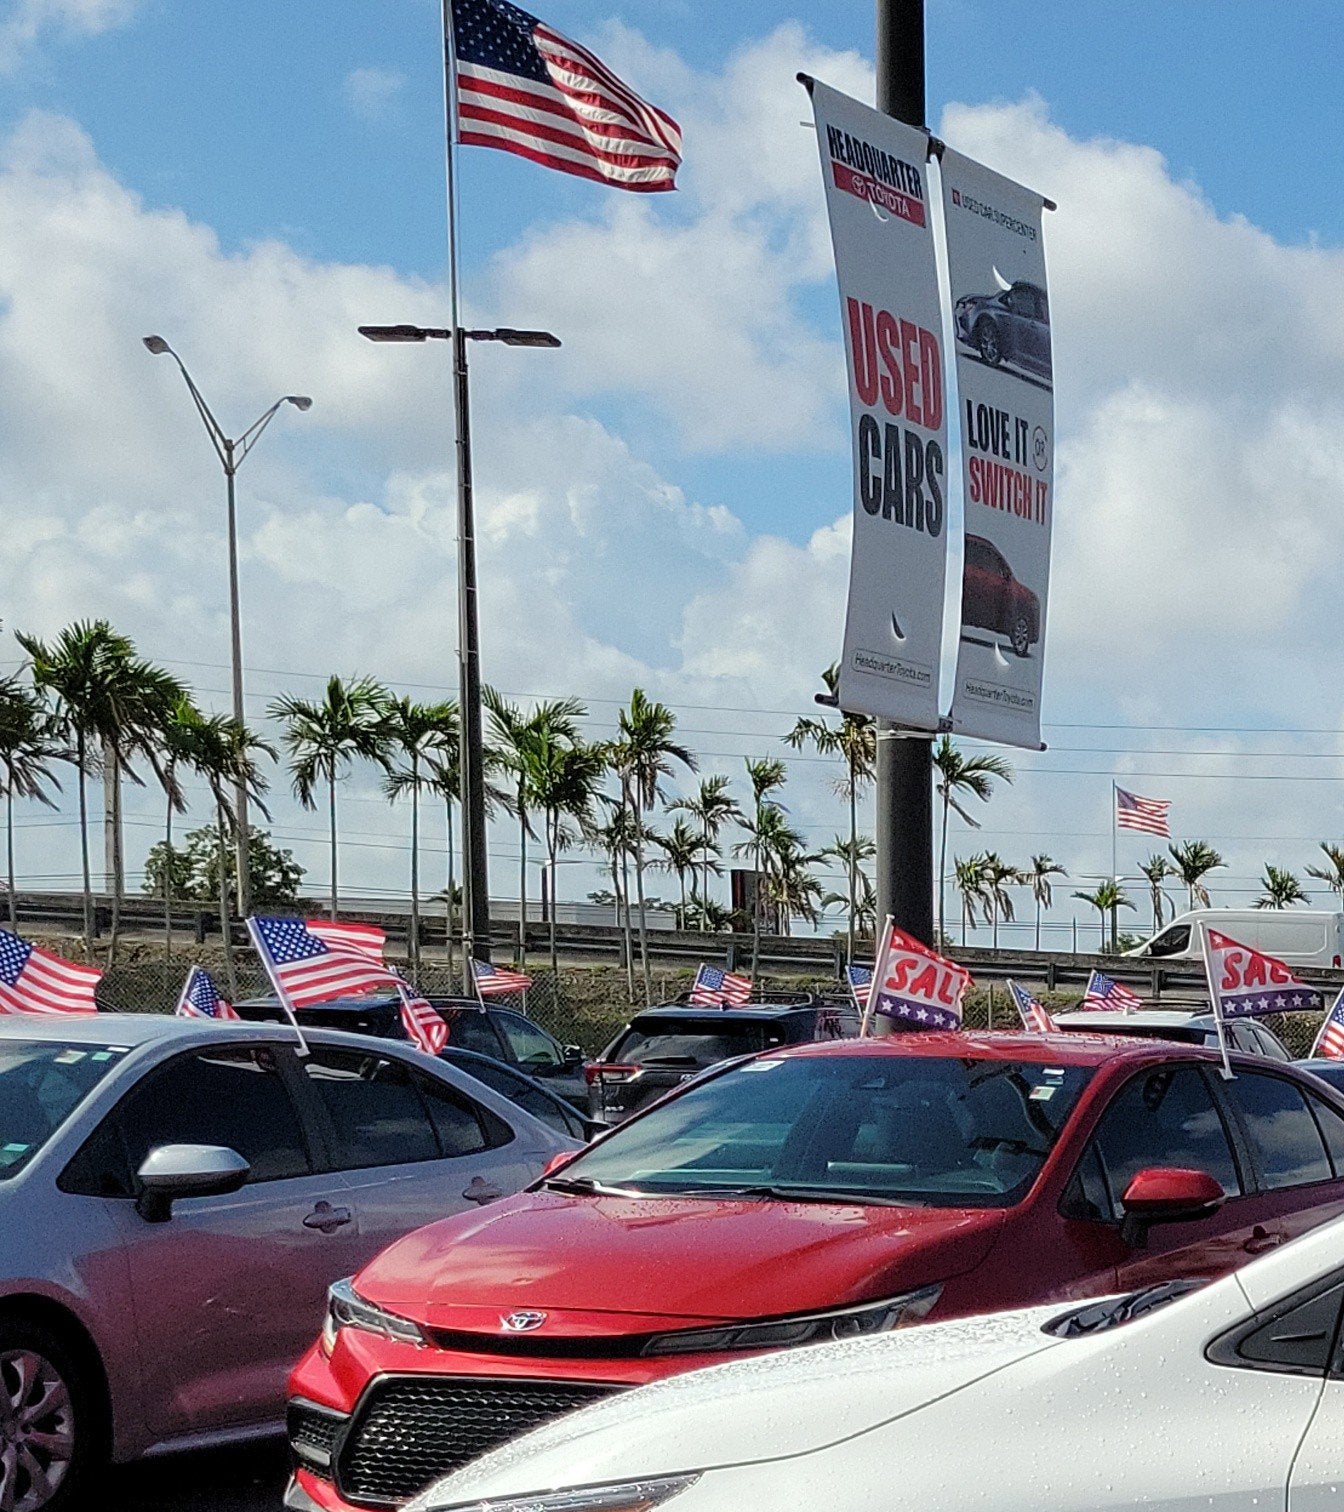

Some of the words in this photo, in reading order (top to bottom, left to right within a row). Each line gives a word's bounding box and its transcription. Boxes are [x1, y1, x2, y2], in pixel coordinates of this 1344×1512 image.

[827, 123, 923, 201] HEADQUARTER
[866, 181, 911, 218] TOYOTA
[847, 296, 943, 431] USED
[966, 398, 1010, 459] LOVE
[1014, 416, 1029, 467] IT
[858, 413, 943, 538] CARS
[969, 456, 1032, 520] SWITCH
[1035, 479, 1047, 525] IT
[855, 652, 931, 683] HeadquarterToyota.com
[885, 957, 966, 1005] SAL
